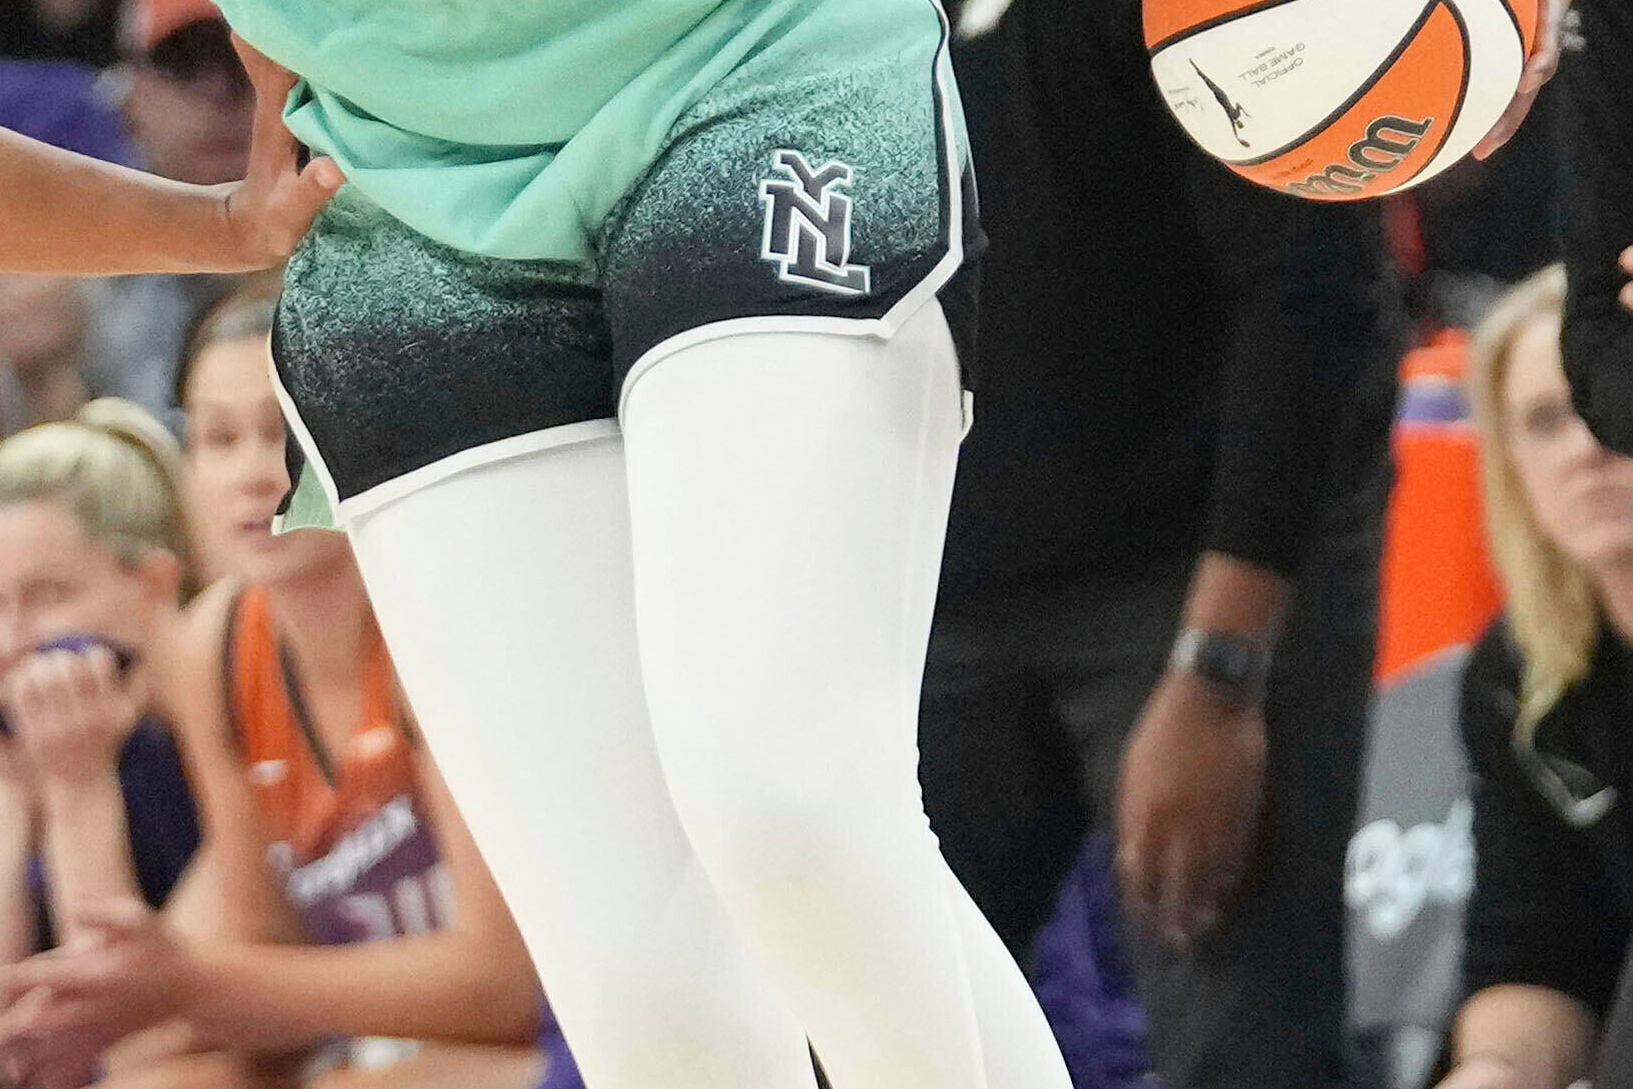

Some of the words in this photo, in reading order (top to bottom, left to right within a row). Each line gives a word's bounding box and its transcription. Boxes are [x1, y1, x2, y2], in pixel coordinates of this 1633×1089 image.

[1269, 42, 1306, 67] GAME
[1238, 62, 1268, 80] BALL
[1251, 57, 1304, 87] OFFICIAL
